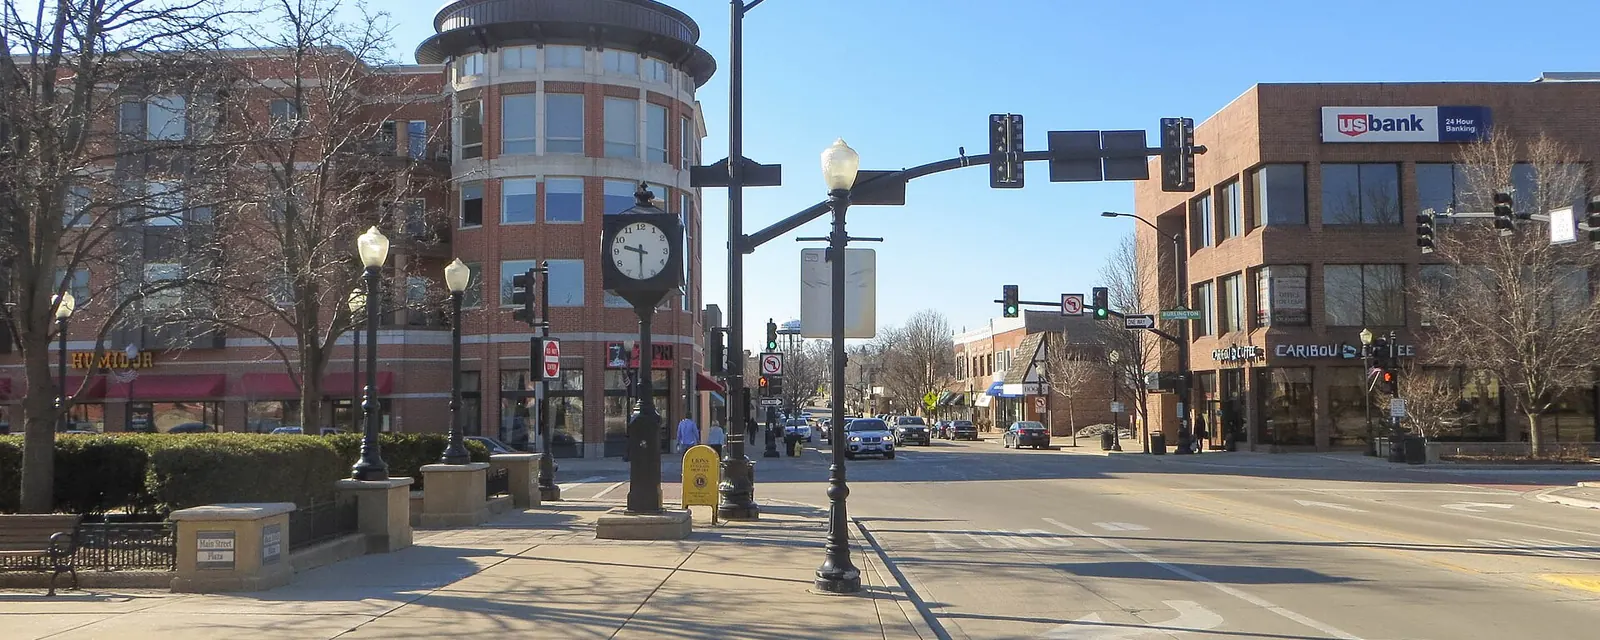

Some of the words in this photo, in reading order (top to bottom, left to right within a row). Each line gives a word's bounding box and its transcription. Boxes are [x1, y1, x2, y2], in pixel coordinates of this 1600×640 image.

[1456, 117, 1474, 125] Hour
[1445, 125, 1475, 134] Banking
[659, 234, 665, 242] 2
[613, 248, 620, 256] 9
[662, 247, 668, 255] 3
[659, 258, 665, 266] 4
[1162, 310, 1198, 318] BURLINGTON
[1276, 344, 1338, 358] CARIBOU
[199, 539, 214, 548] Main
[215, 539, 232, 548] Street
